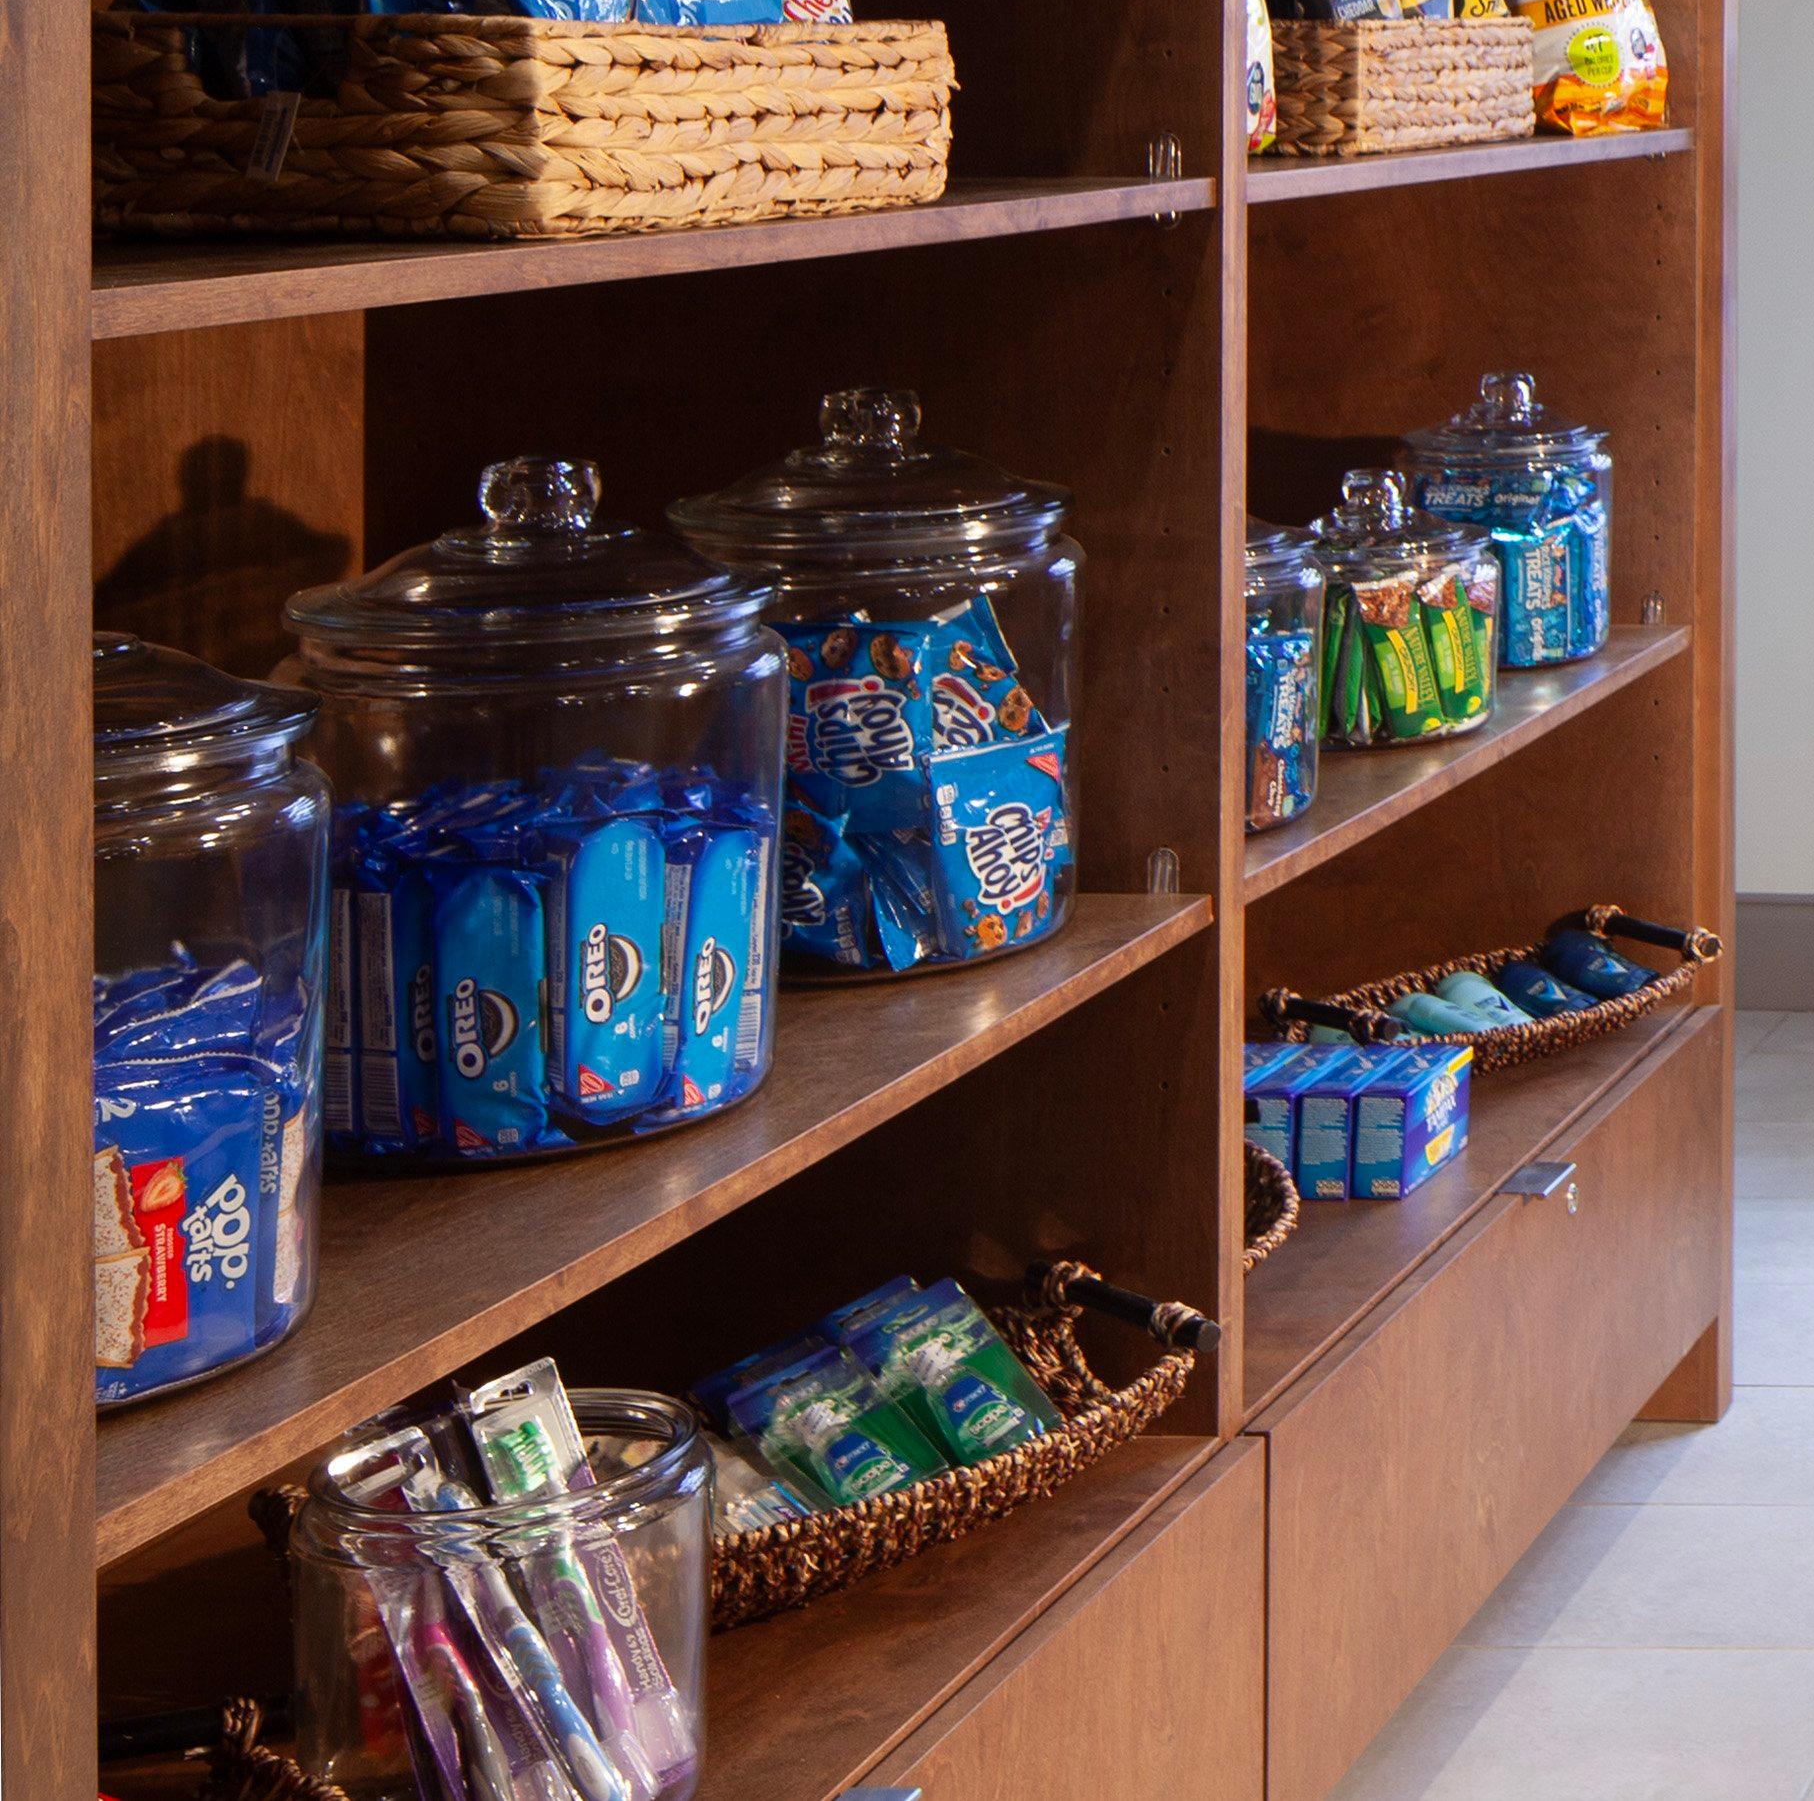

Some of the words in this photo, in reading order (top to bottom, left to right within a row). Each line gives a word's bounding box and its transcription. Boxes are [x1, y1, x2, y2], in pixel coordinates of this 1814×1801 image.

[988, 803, 1042, 884] Chips
[580, 923, 613, 1025] OREO
[692, 935, 717, 1037] OREO
[452, 977, 487, 1080] OREO
[154, 1222, 168, 1302] STRAWBERRY
